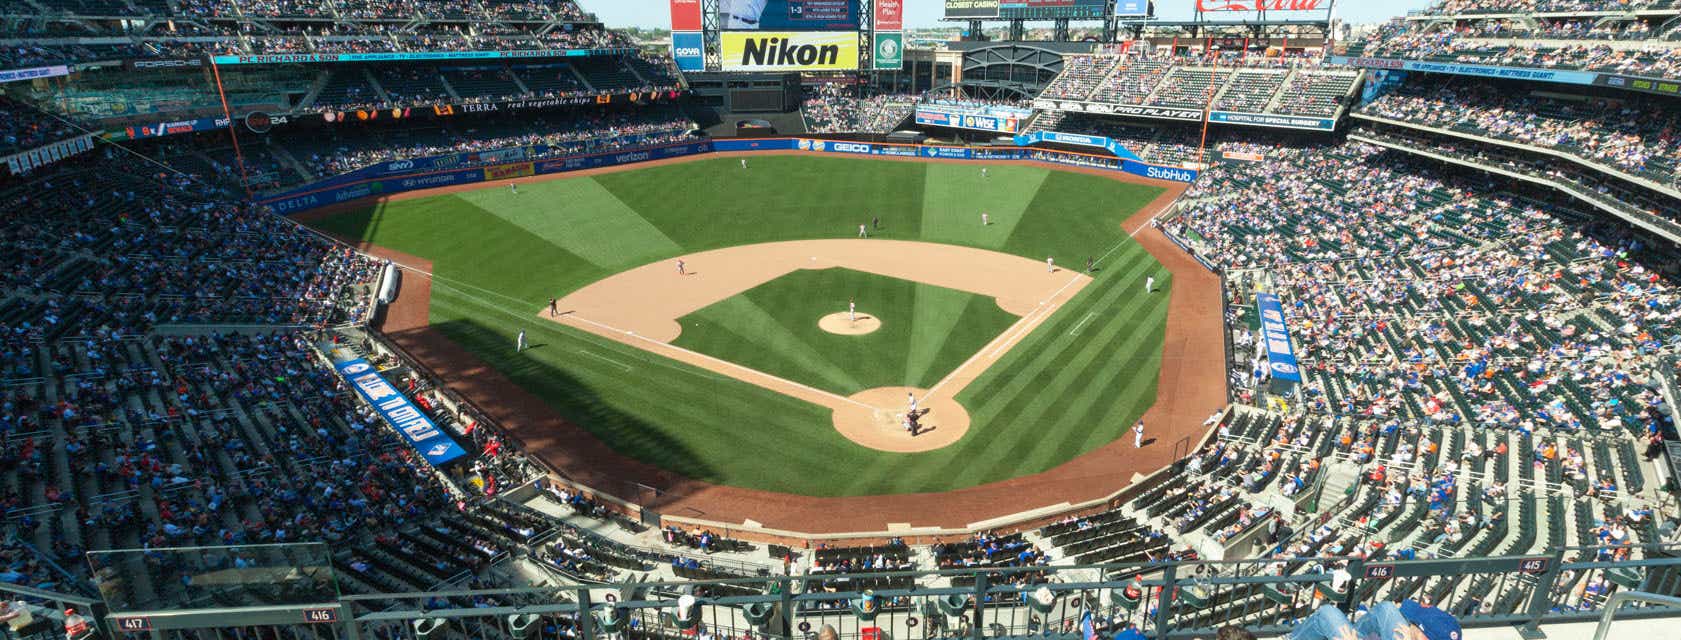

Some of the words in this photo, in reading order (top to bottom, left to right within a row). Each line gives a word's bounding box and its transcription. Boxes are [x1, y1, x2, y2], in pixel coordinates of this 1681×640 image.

[742, 37, 839, 65] Nikon
[134, 59, 201, 68] PORSCHE
[257, 54, 308, 63] RICHARD
[319, 54, 339, 62] SON
[1458, 66, 1495, 75] ELECTRONICS
[1499, 69, 1531, 77] MATTRESS
[462, 103, 498, 112] TERRA
[507, 100, 525, 108] real
[528, 98, 567, 108] vegetable
[569, 97, 591, 105] chips
[1113, 105, 1143, 115] PRO
[1144, 106, 1200, 119] PLAYER
[270, 116, 288, 125] 24
[1265, 117, 1290, 125] SPECIAL
[1291, 118, 1321, 126] SURGERY
[1063, 135, 1092, 144] HONDA
[834, 142, 869, 153] GEICO
[615, 151, 649, 163] verizon
[1147, 166, 1191, 181] StubHub
[279, 195, 318, 212] DELTA
[1524, 559, 1540, 571] 415
[1371, 567, 1387, 578] 416
[311, 609, 330, 621] 416
[125, 617, 142, 629] 417
